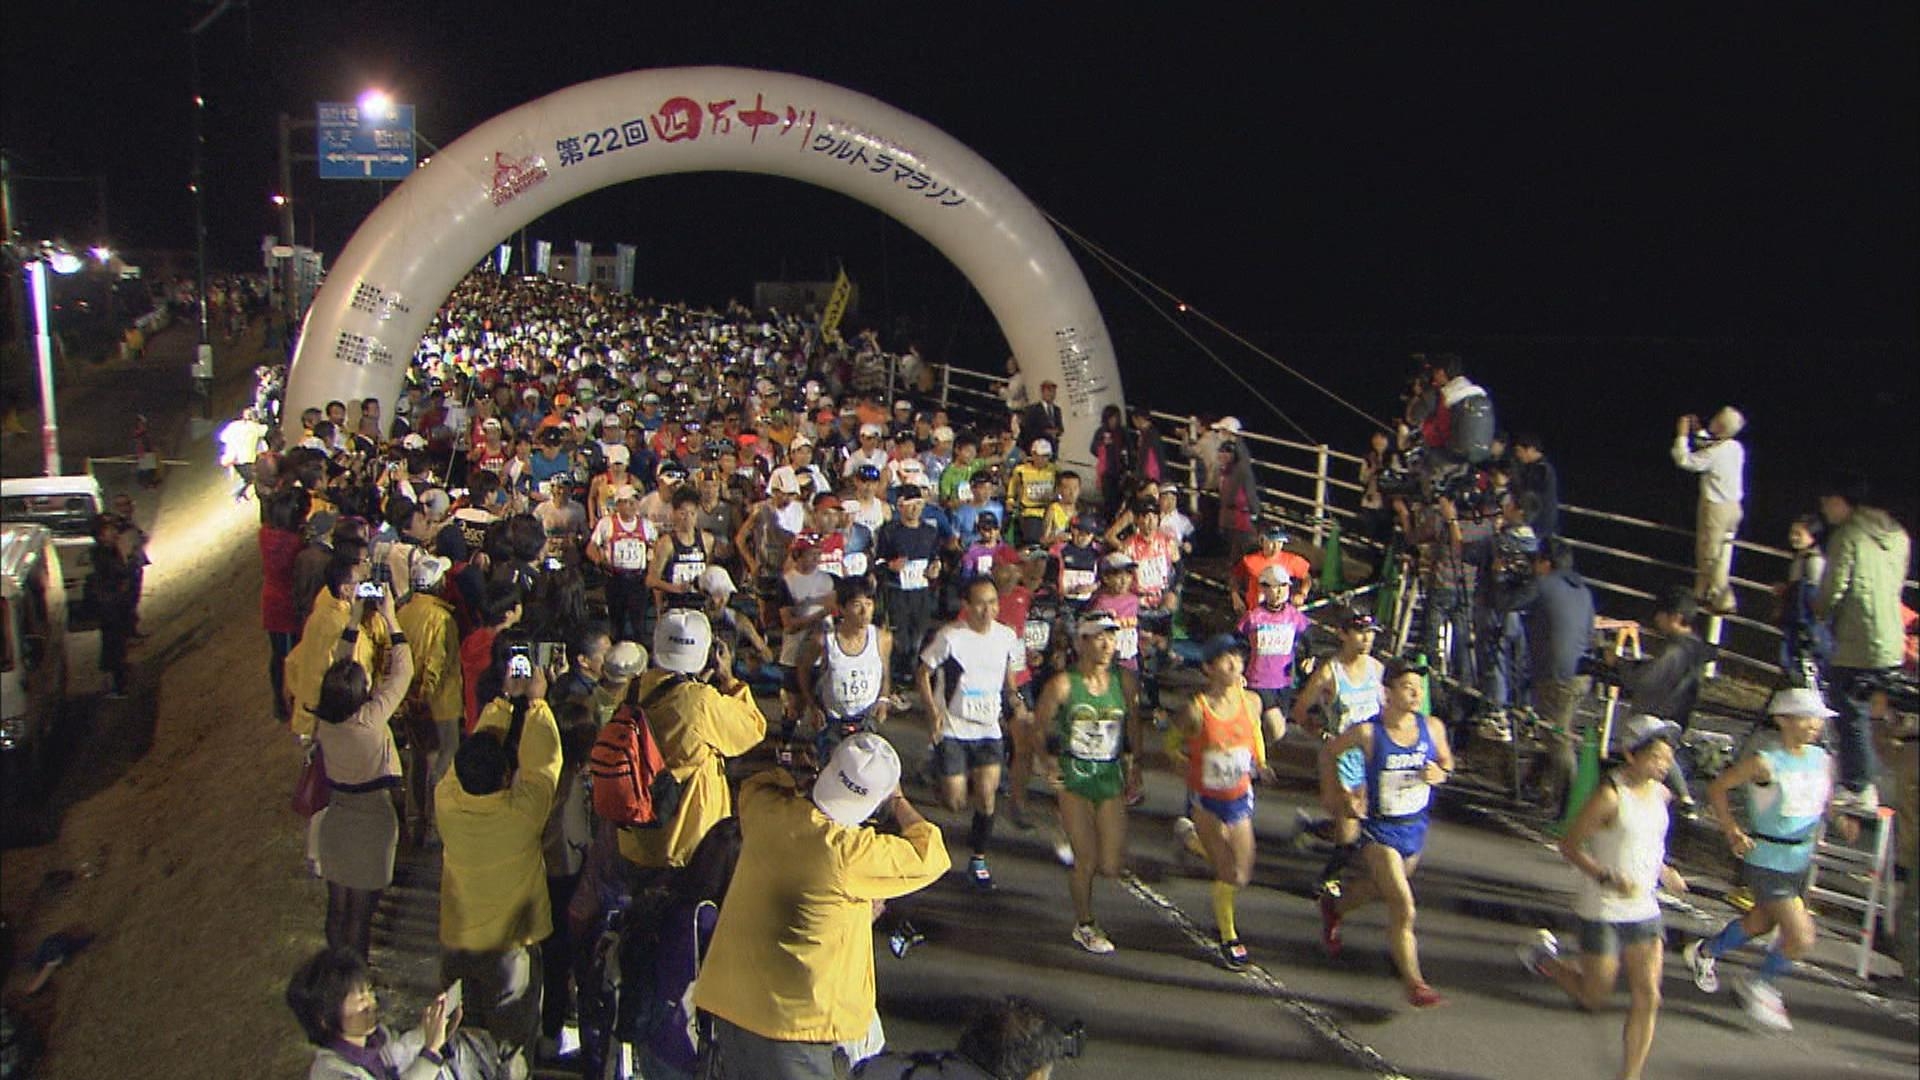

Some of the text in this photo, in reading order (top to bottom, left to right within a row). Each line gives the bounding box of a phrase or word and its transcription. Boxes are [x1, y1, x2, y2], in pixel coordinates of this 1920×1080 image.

[556, 119, 649, 167] 第22回
[650, 93, 817, 153] 四万十川
[812, 133, 967, 206] ウルトラマラソン
[842, 679, 868, 697] 169
[838, 769, 869, 796] PRESS
